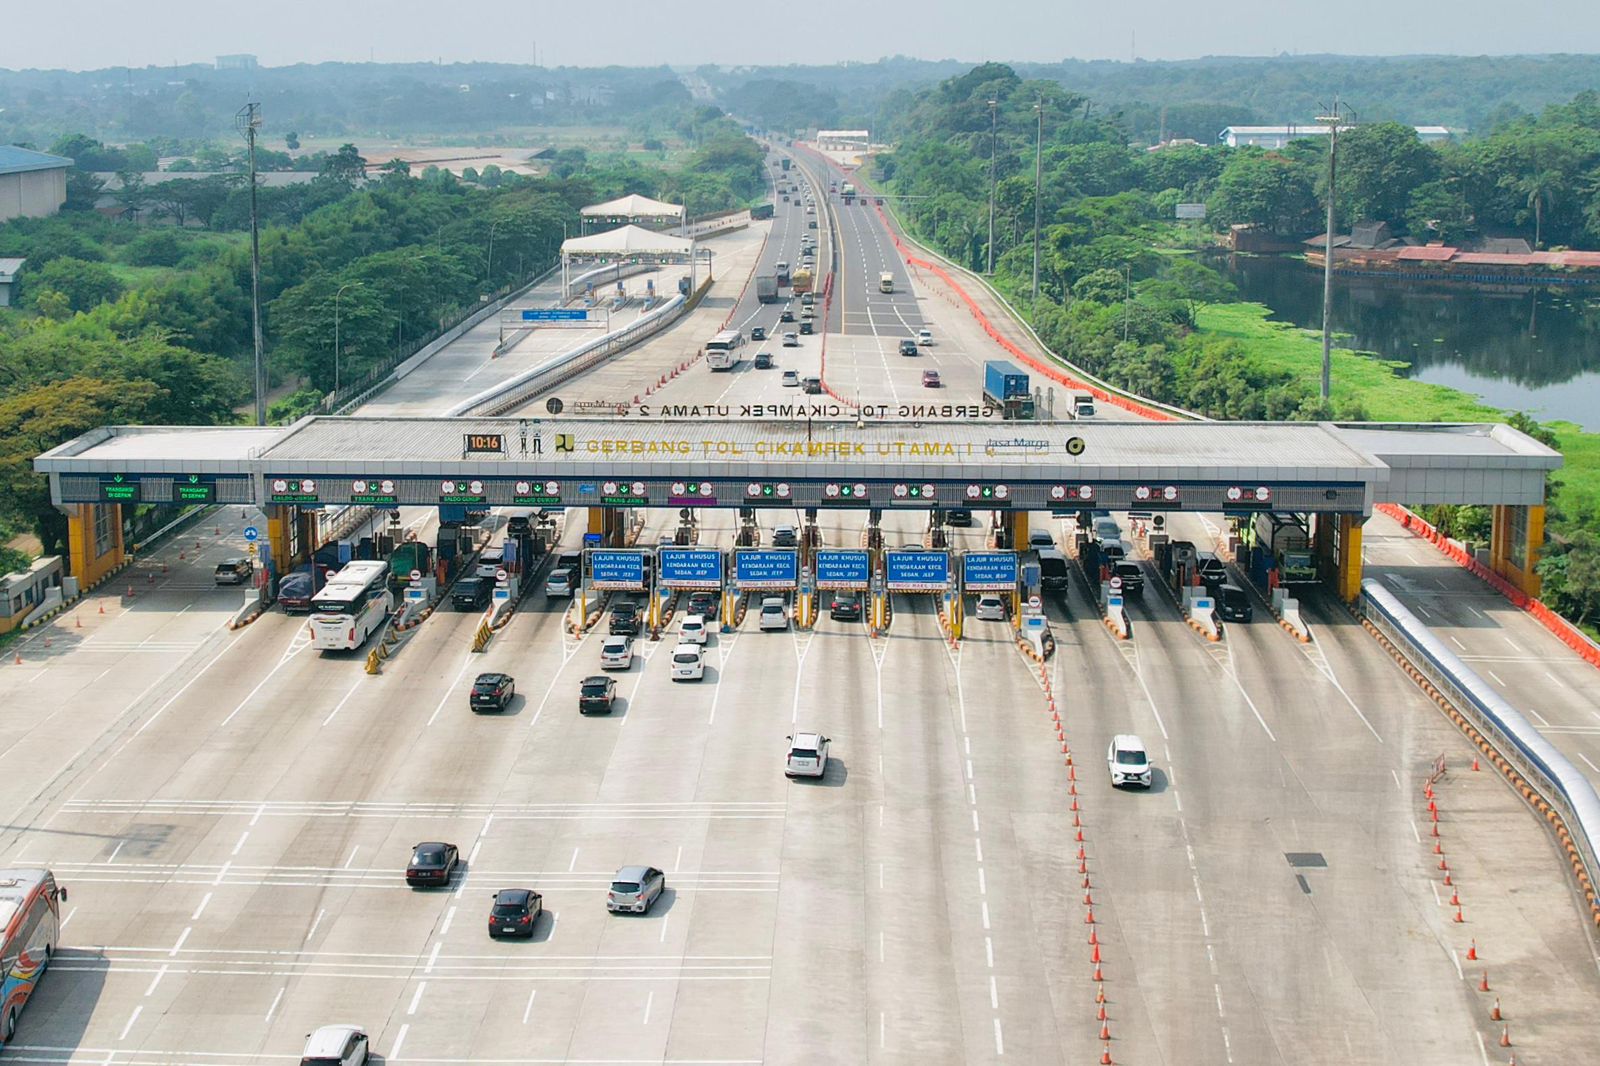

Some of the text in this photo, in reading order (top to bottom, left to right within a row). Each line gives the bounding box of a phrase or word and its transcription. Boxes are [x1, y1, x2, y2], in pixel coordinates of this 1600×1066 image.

[470, 436, 498, 448] 10:16
[586, 440, 690, 454] GERBANG
[702, 440, 744, 455] TOL
[755, 441, 866, 456] CIKAMPEK
[878, 442, 954, 456] UTAMA
[1014, 438, 1049, 450] Marga
